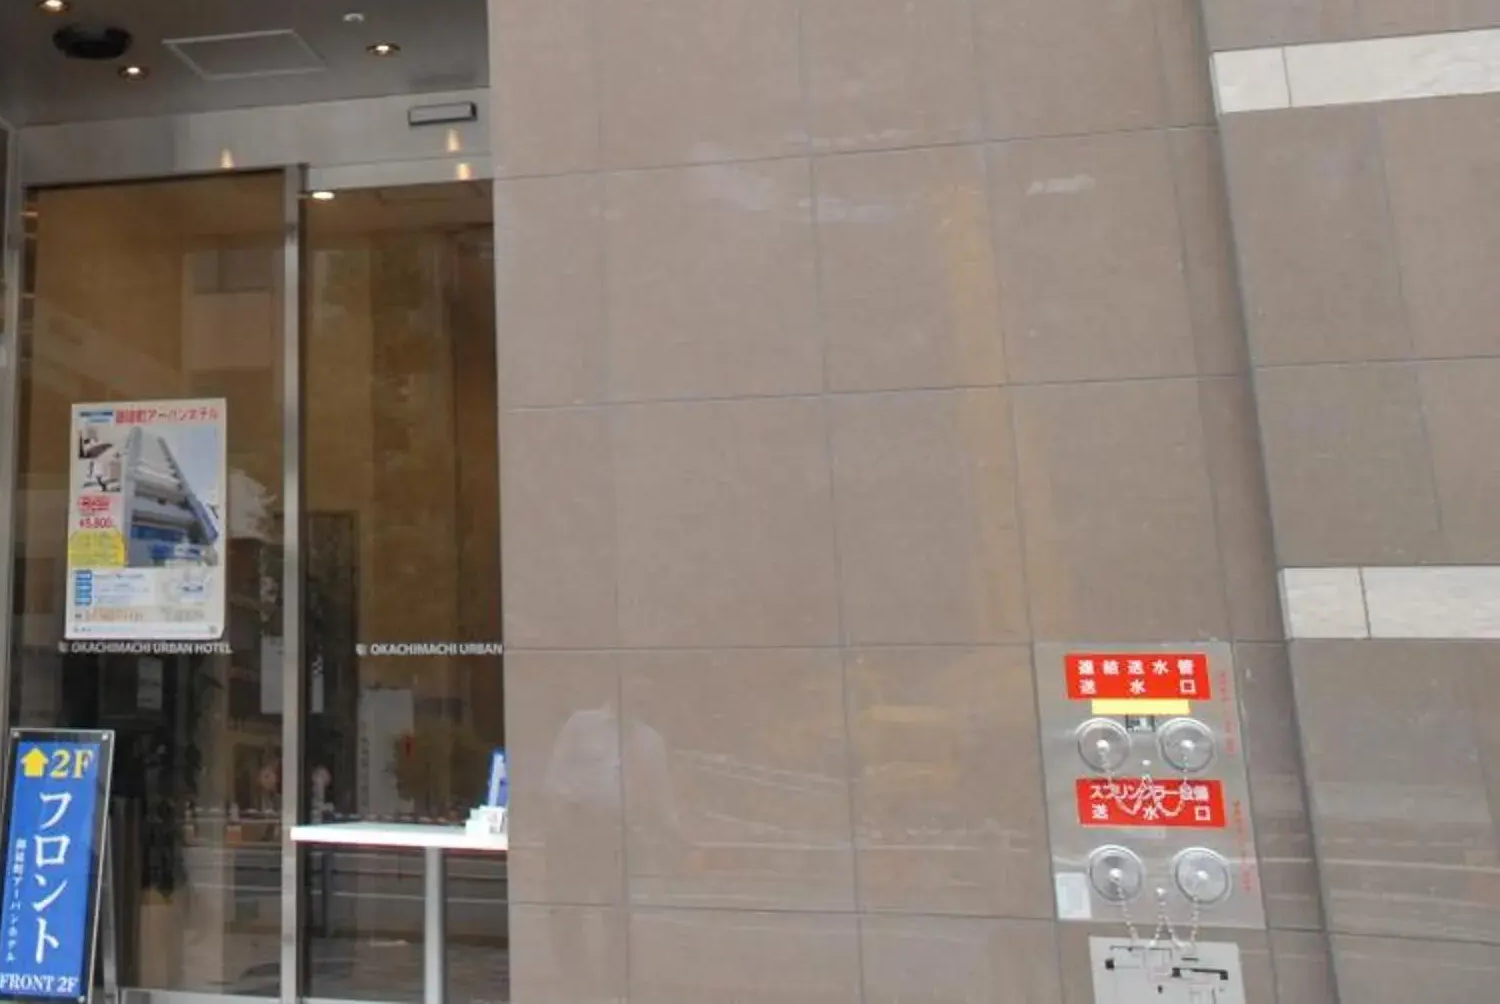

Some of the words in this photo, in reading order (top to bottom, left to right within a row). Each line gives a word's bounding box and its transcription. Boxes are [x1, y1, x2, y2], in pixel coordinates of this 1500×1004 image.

[71, 642, 150, 654] OKACHIMACHI
[153, 642, 192, 654] URBAN
[195, 642, 233, 654] HOTEL
[370, 643, 457, 656] OKACHIMACHI
[459, 643, 502, 655] URBAN
[49, 748, 94, 779] 2F
[30, 792, 73, 964] フロント
[0, 972, 55, 992] FRONT
[56, 975, 79, 994] 2F
